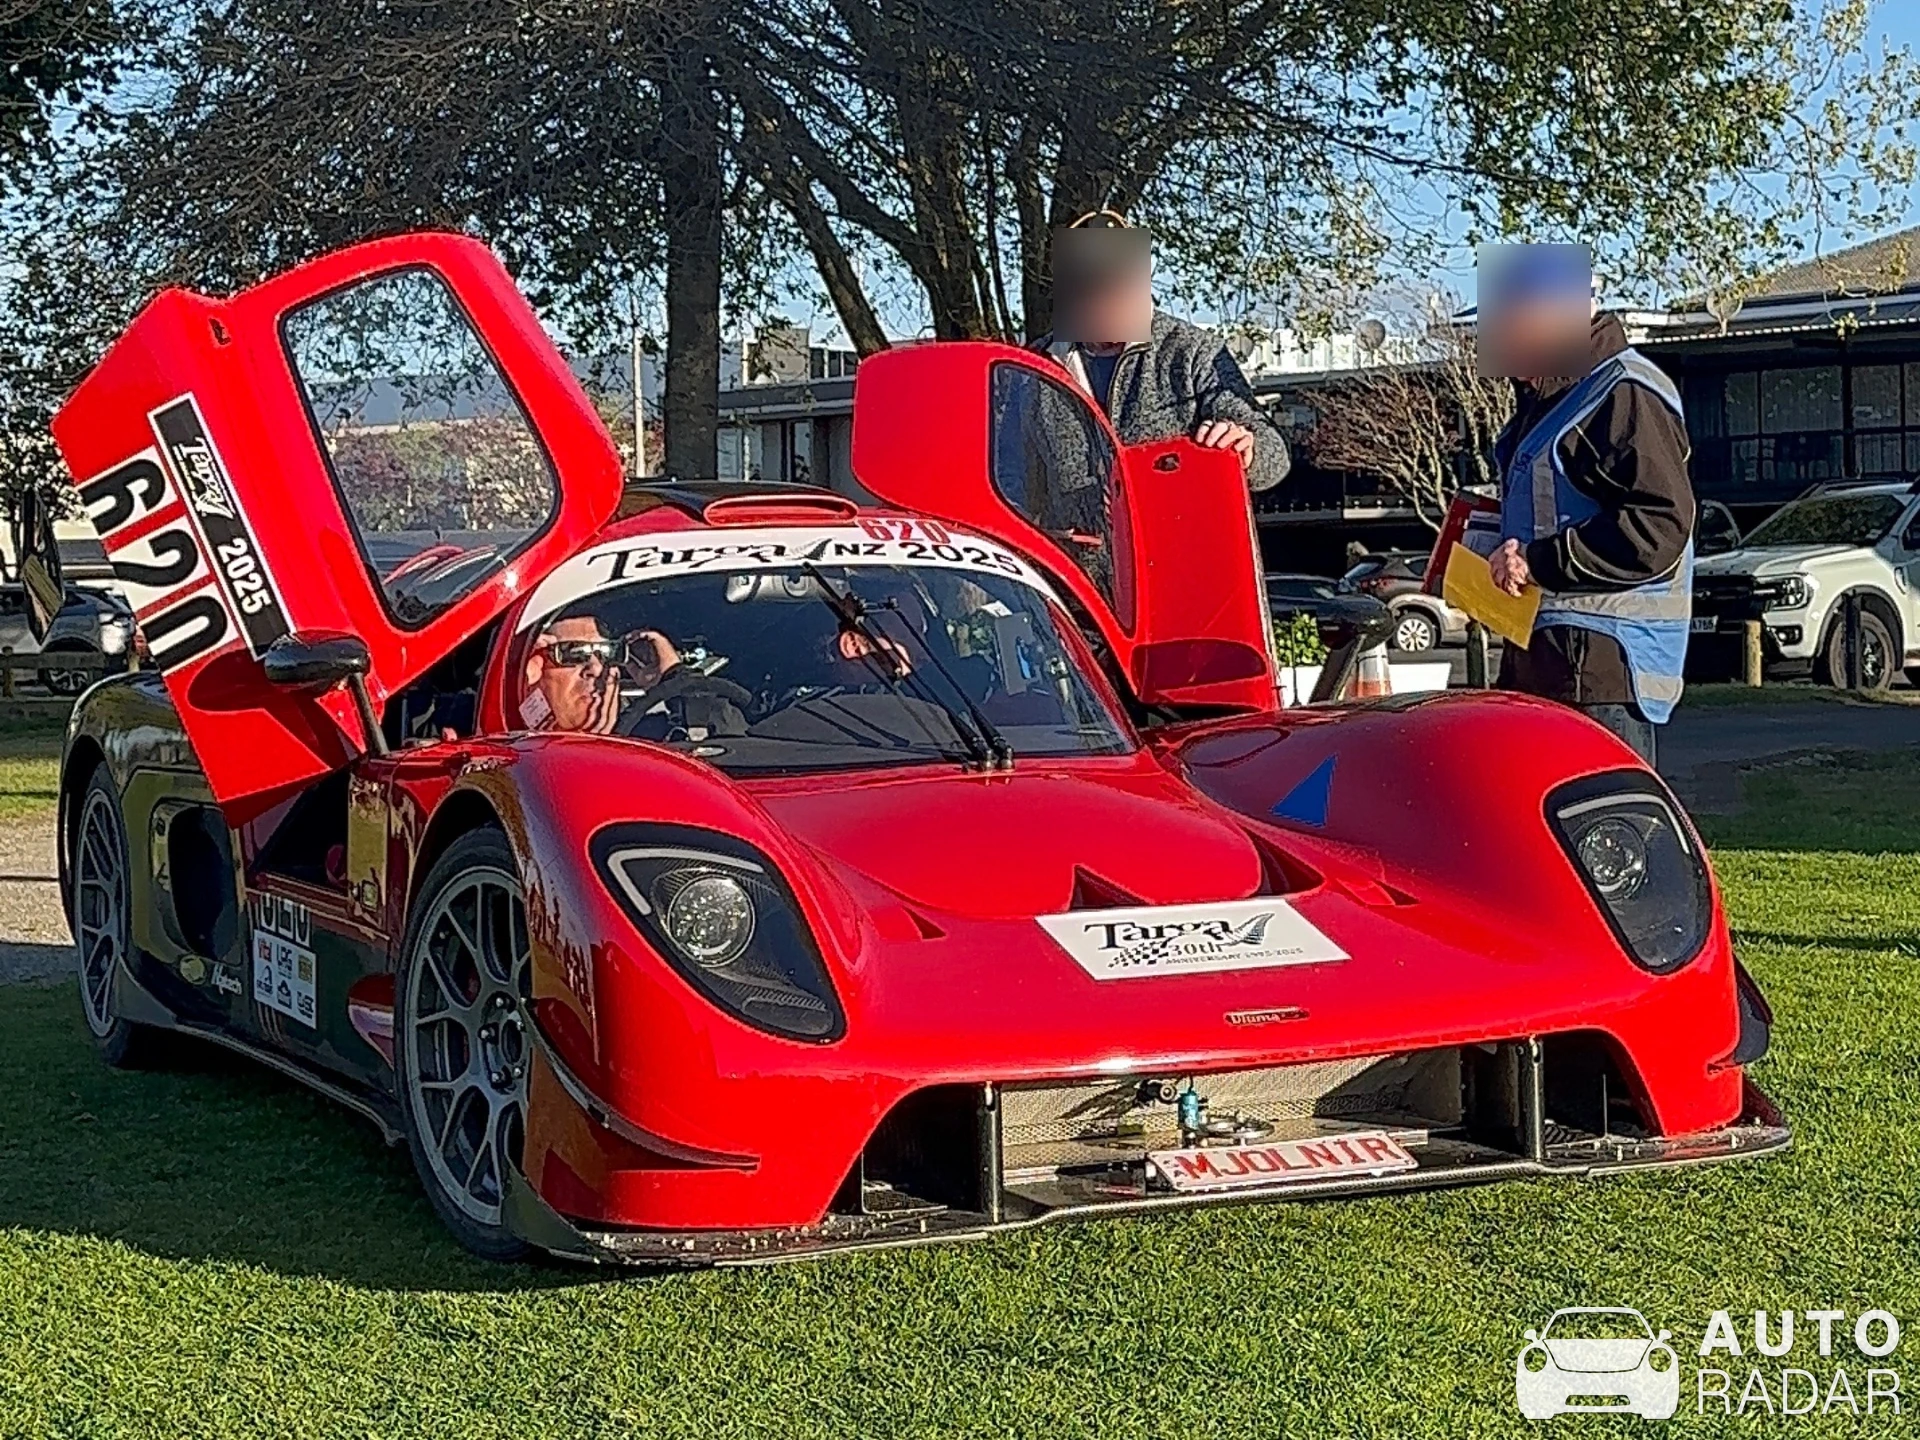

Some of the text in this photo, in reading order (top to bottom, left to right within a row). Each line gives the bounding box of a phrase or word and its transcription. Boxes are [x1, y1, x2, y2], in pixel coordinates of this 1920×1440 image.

[857, 519, 951, 544] 620
[217, 537, 271, 614] 2025
[587, 542, 1024, 586] Targa NZ 2025
[1083, 920, 1233, 951] Targa
[1165, 953, 1241, 965] ANNIVERSARY
